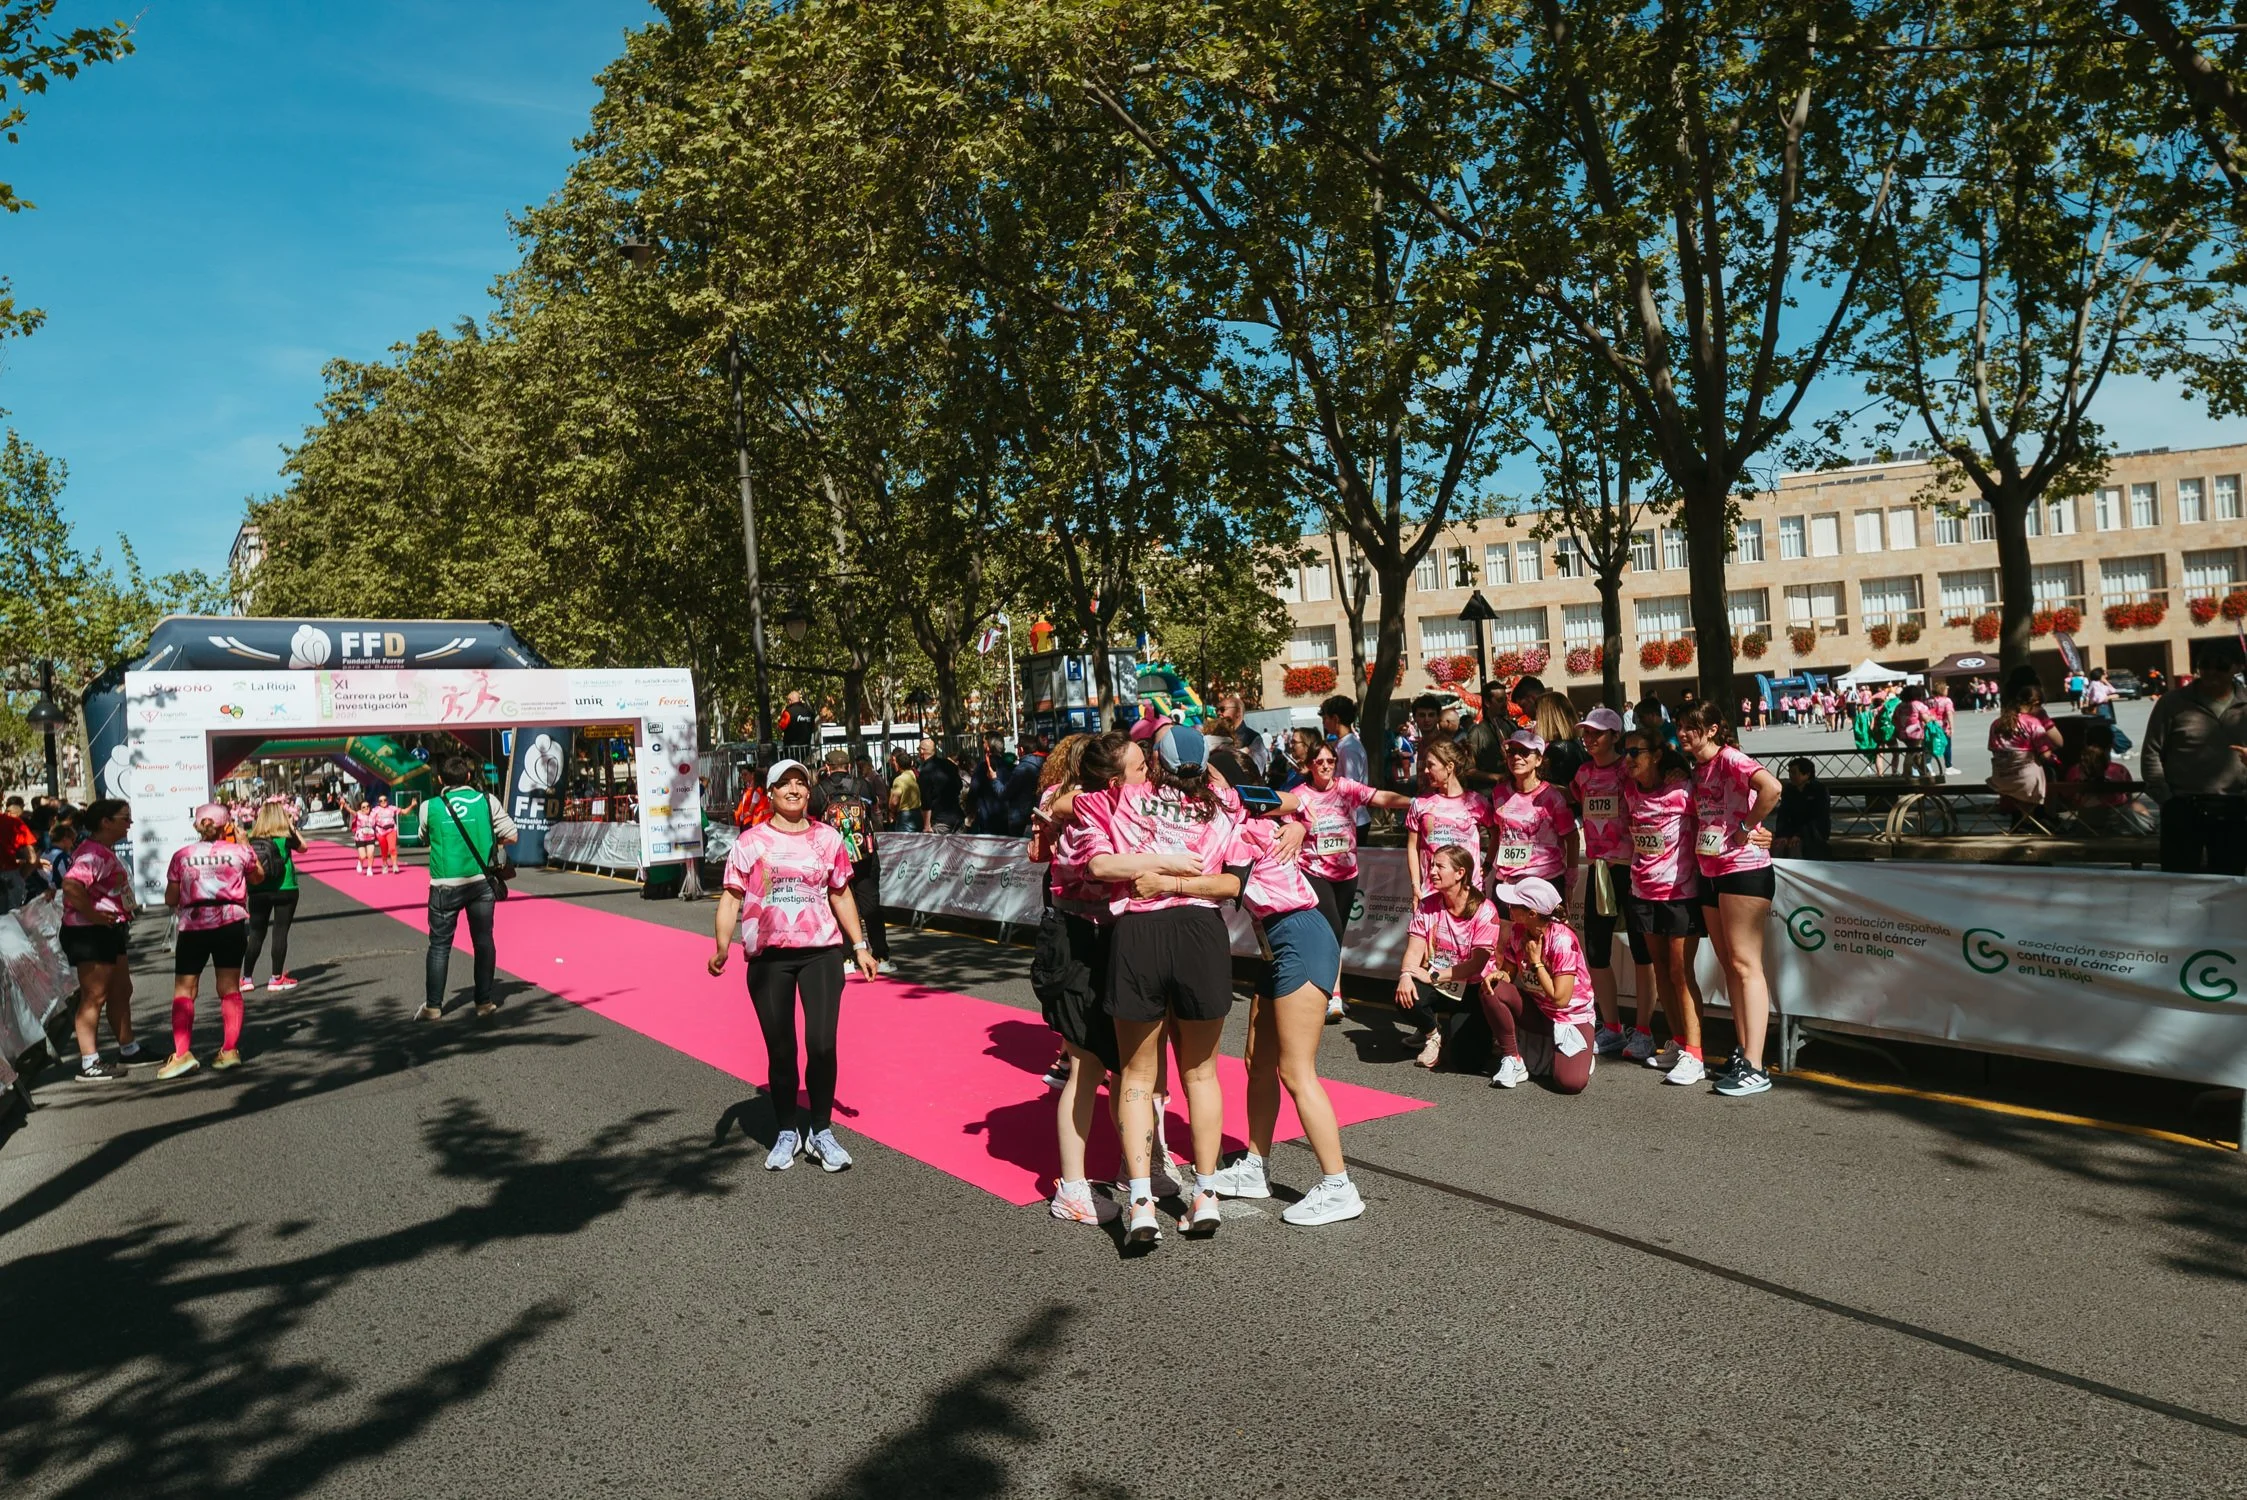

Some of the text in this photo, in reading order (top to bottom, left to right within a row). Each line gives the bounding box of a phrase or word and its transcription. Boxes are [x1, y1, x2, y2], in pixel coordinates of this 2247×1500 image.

[341, 632, 405, 657] FFD
[251, 681, 296, 692] La Rioja
[334, 680, 348, 690] XI
[334, 691, 409, 703] Carrera por la
[335, 701, 408, 711] investigación
[515, 796, 560, 818] FFD
[1588, 799, 1611, 811] 8178
[1634, 834, 1658, 848] 5923
[1504, 848, 1526, 859] 8675
[771, 866, 778, 874] XI
[772, 876, 802, 884] Carrera
[786, 885, 794, 893] la
[1834, 916, 1952, 936] asociación española
[1834, 929, 1928, 948] contra el cáncer
[1834, 942, 1894, 960] en La Rioja
[2018, 938, 2169, 964] asociación española
[2016, 951, 2136, 974] contra el cáncer
[2018, 964, 2093, 984] en La Rioja
